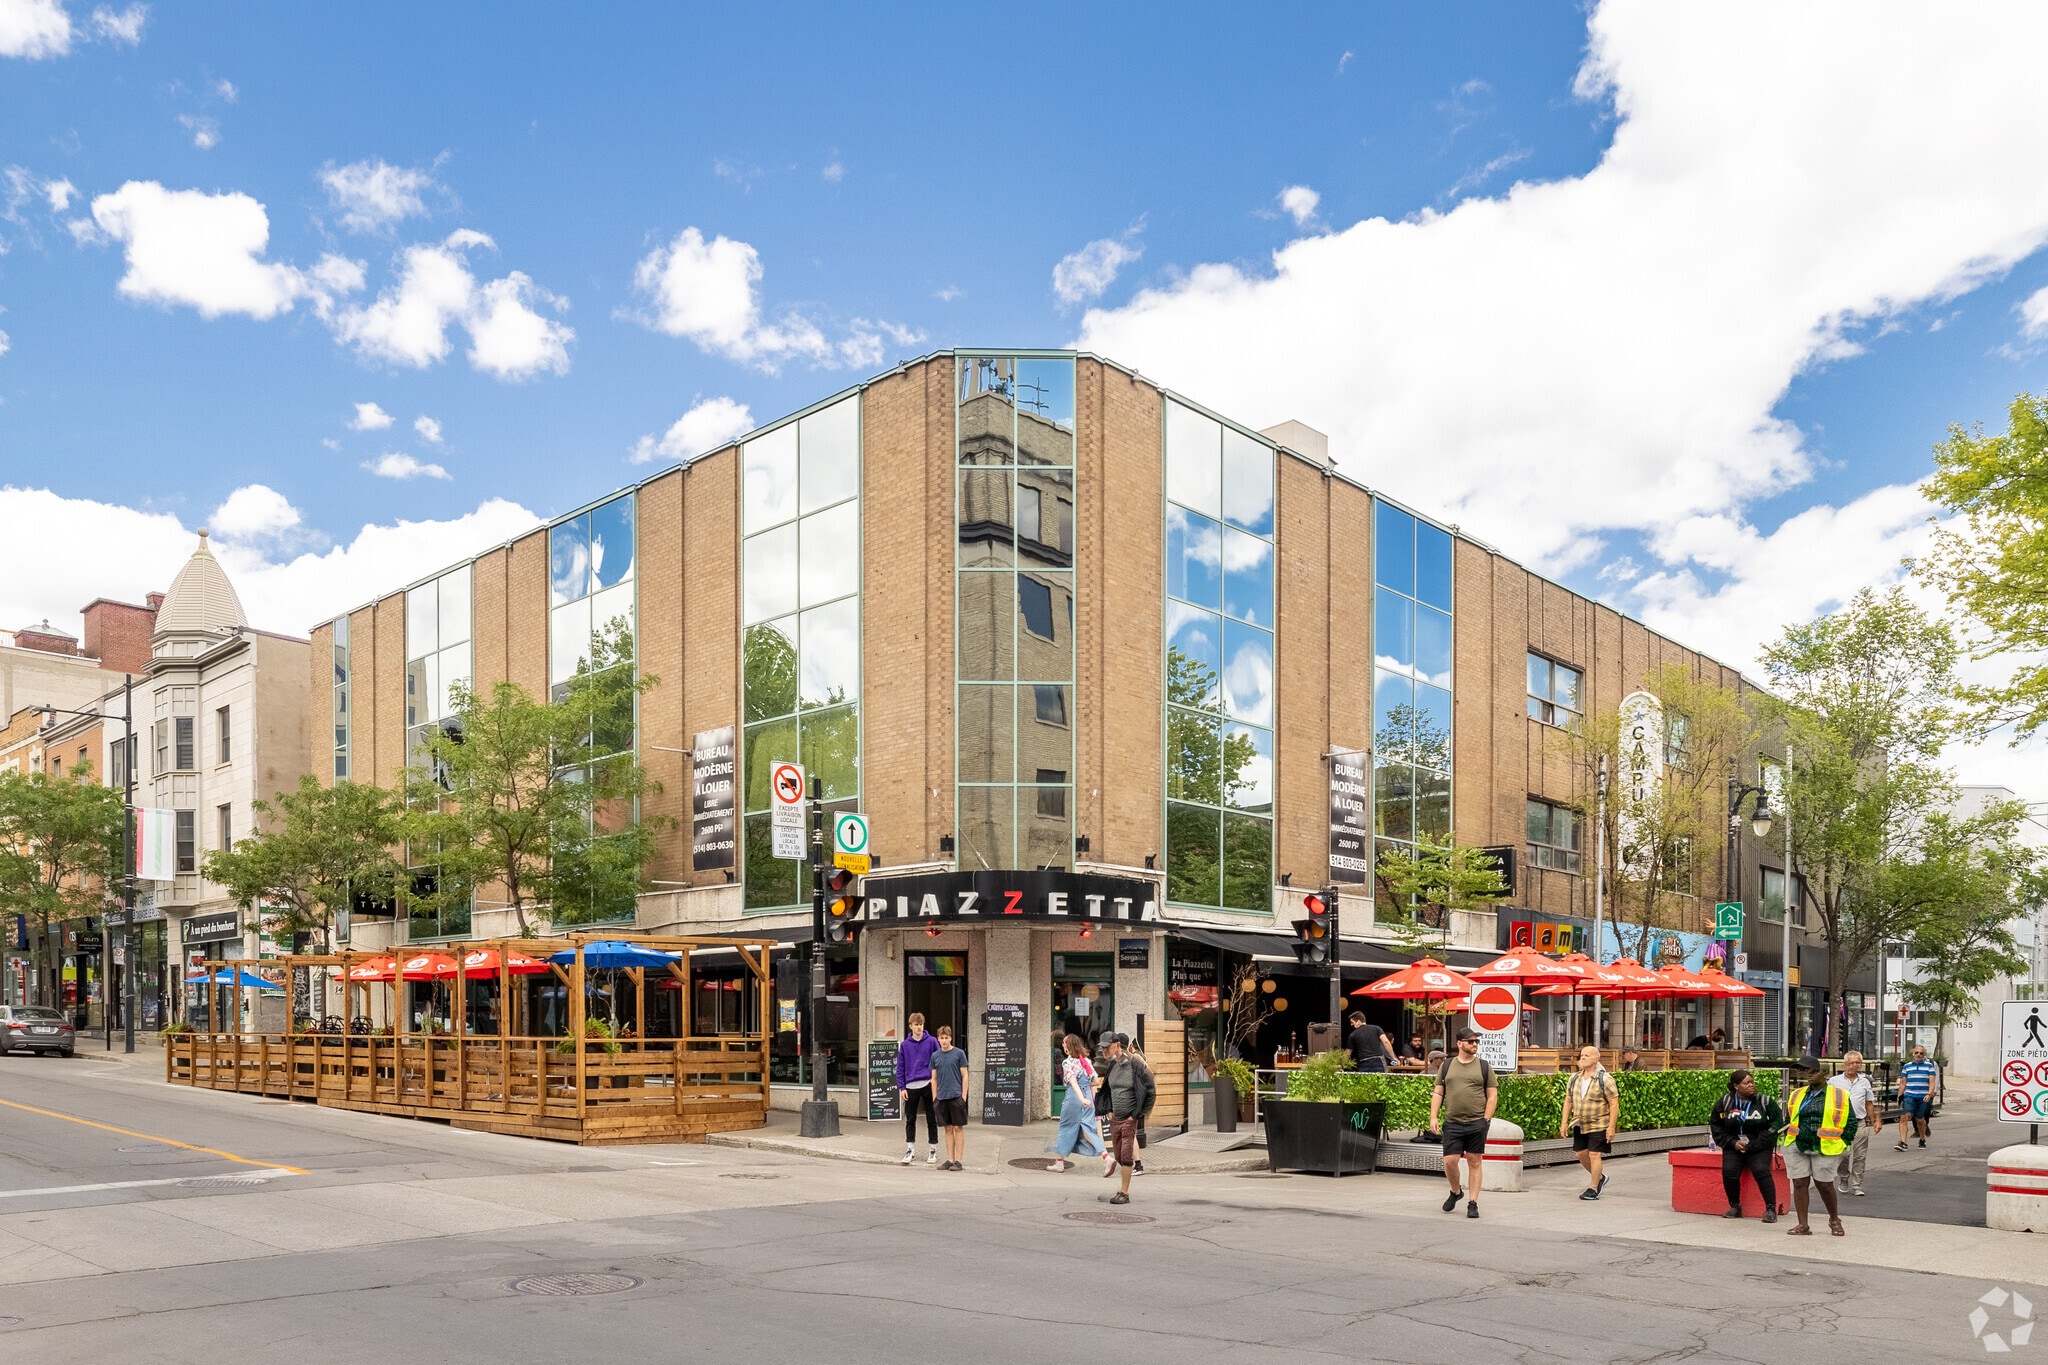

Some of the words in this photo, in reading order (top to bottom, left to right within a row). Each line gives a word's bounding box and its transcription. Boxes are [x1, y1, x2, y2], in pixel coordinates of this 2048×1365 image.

[696, 745, 729, 762] BUREAU
[693, 761, 733, 779] MODÈRNE
[1335, 763, 1363, 780] BUREAU
[695, 784, 701, 797] À
[701, 780, 730, 794] LOUER
[1331, 780, 1366, 797] MODÈRNE
[703, 799, 719, 809] LIBRE
[1335, 795, 1341, 808] À
[1342, 798, 1364, 812] LOUER
[693, 808, 734, 821] IMMÉDIATEMENT
[1344, 815, 1357, 824] LIBRE
[701, 826, 714, 835] 2600
[1331, 823, 1366, 836] IMMÉDIATEMENT
[693, 843, 705, 854] (514)
[705, 840, 734, 851] 803-0630
[1338, 839, 1351, 849] 2600
[869, 890, 1160, 922] PIAZZETTA
[194, 927, 200, 935] un
[200, 923, 211, 937] pied
[211, 922, 217, 932] du
[216, 920, 235, 932] bonheur
[1172, 958, 1181, 967] La
[1183, 958, 1215, 969] Piazzetta.
[1172, 970, 1187, 980] Plus
[1189, 973, 1201, 982] que
[1172, 982, 1180, 992] de
